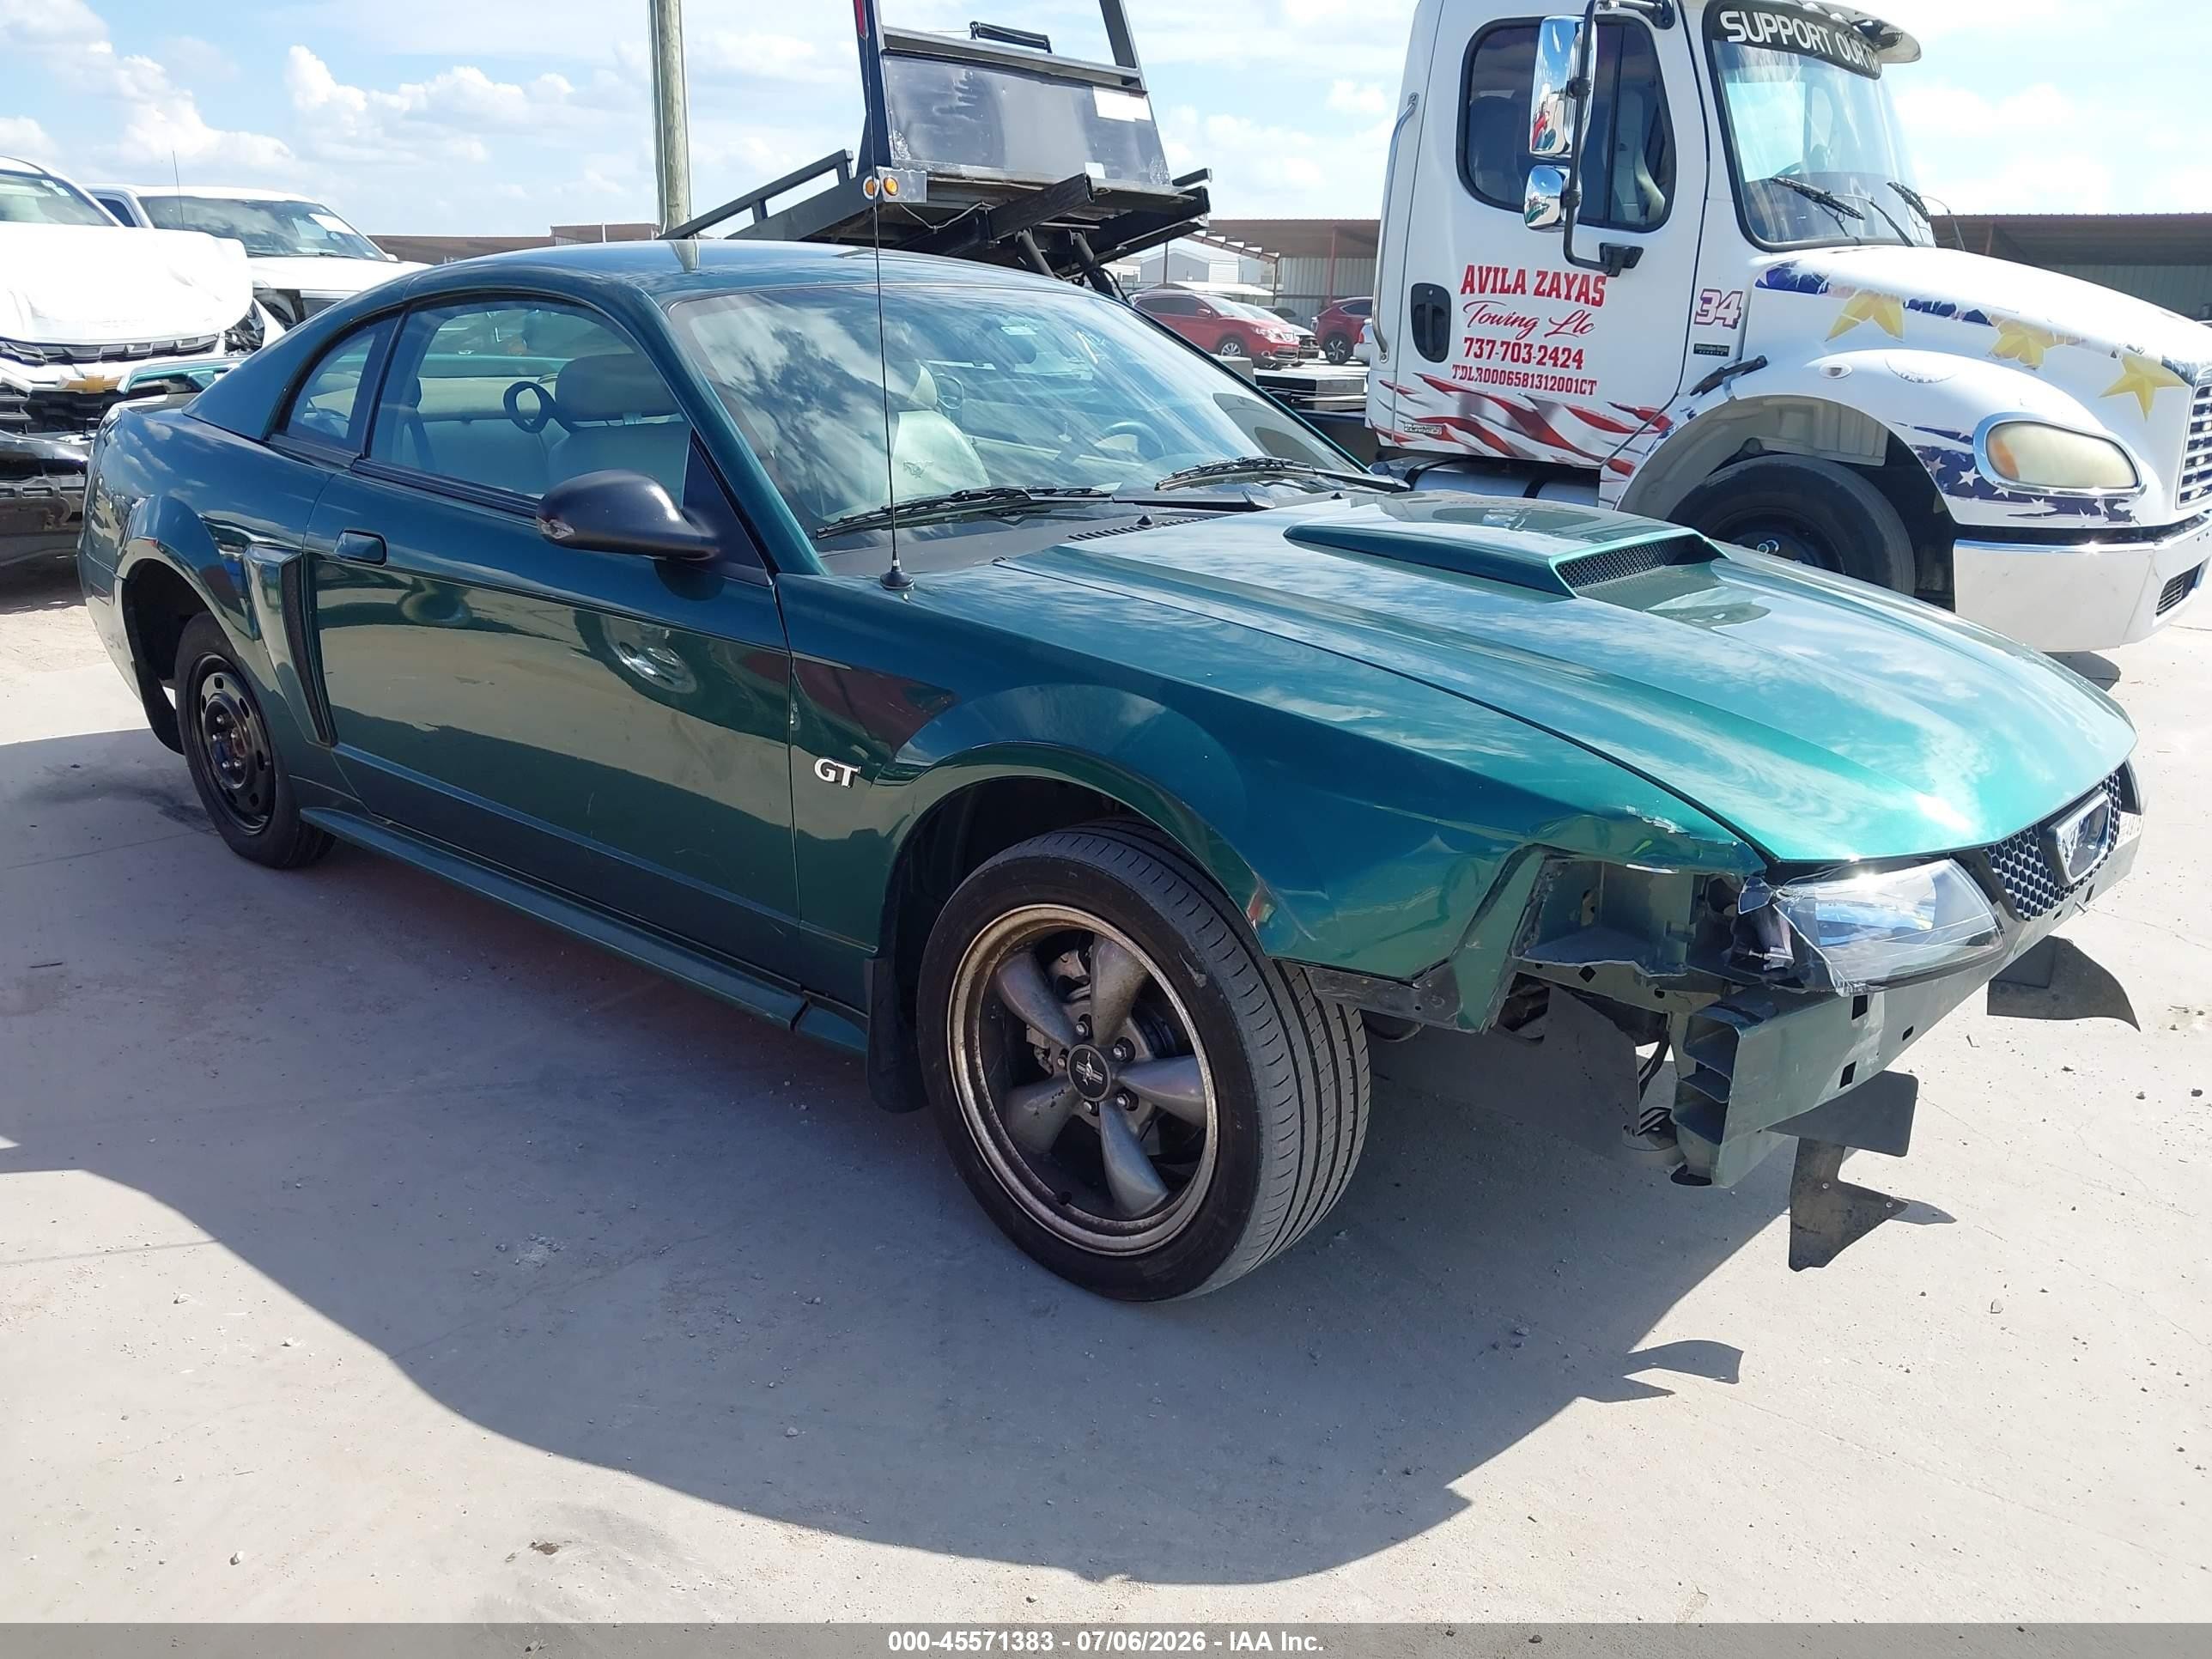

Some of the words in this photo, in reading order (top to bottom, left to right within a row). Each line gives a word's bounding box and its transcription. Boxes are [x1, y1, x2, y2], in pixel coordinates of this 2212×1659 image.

[1720, 10, 1833, 55] SUPPORT
[1834, 31, 1869, 69] OUR
[1461, 264, 1527, 295] AVILA
[1533, 270, 1607, 307] ZAYAS
[1462, 300, 1540, 340] Towing
[1693, 288, 1743, 330] 34
[1464, 337, 1584, 370] 737-703-2424
[814, 758, 861, 788] GT
